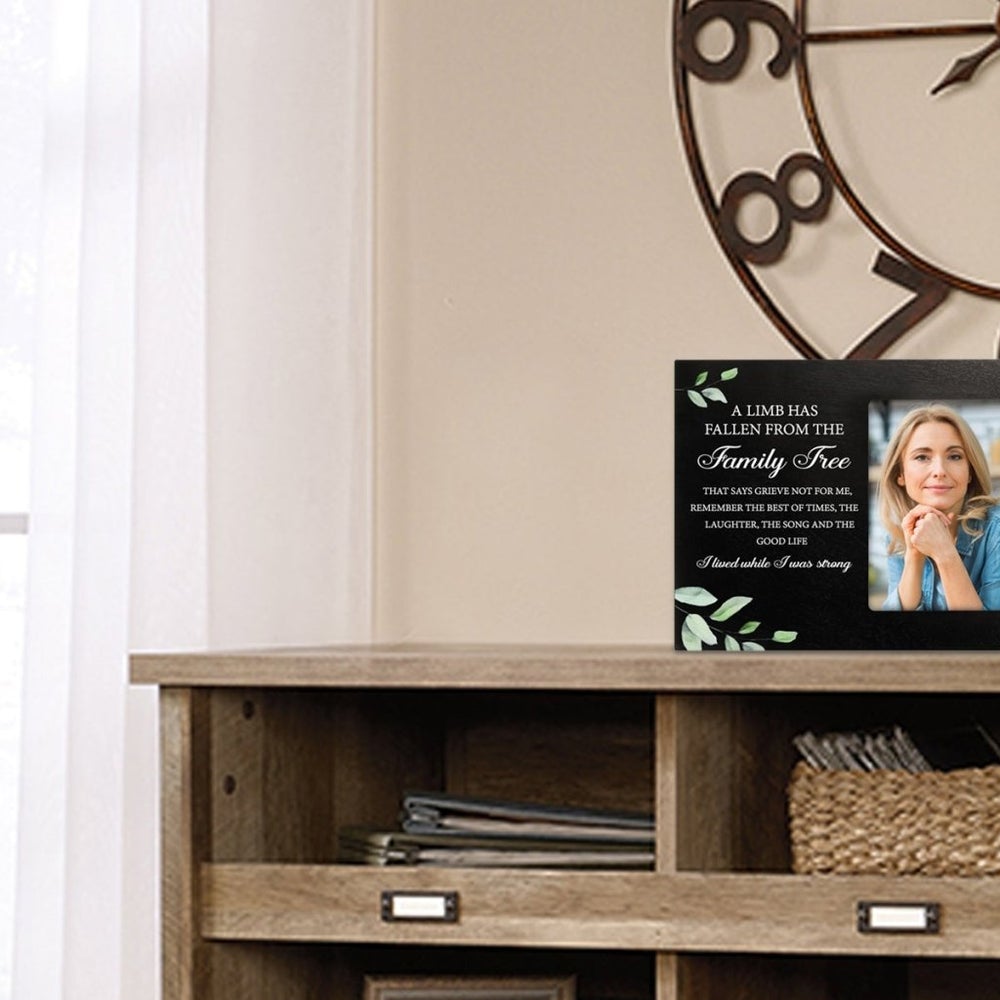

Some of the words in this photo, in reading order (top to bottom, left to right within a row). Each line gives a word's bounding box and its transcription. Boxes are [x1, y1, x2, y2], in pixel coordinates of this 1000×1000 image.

[719, 152, 834, 265] 8
[731, 404, 743, 417] A
[746, 404, 785, 417] LIMB
[787, 404, 819, 417] HAS
[704, 422, 762, 436] FALLEN
[765, 422, 810, 436] FROM
[812, 422, 845, 436] THE
[696, 444, 787, 479] Family
[792, 444, 852, 470] Tree
[703, 486, 730, 495] THAT
[730, 486, 753, 496] SAYS
[754, 486, 790, 496] GRIEVE
[791, 486, 813, 496] NOT
[814, 486, 834, 496] FOR
[835, 486, 853, 498] ME,
[690, 503, 744, 512] REMEMBER
[745, 503, 765, 512] THE
[766, 503, 790, 512] BEST
[791, 503, 805, 512] OF
[805, 503, 838, 514] TIMES,
[839, 503, 859, 512] THE
[705, 520, 759, 531] LAUGHTER,
[761, 520, 782, 529] THE
[782, 520, 810, 529] SONG
[811, 520, 834, 529] AND
[834, 520, 855, 529] THE
[756, 537, 786, 546] GOOD
[787, 537, 808, 546] LIFE
[696, 555, 714, 569] I
[711, 556, 741, 569] lived
[740, 556, 771, 569] while
[774, 555, 791, 569] I
[789, 560, 813, 569] was
[815, 559, 852, 573] strong
